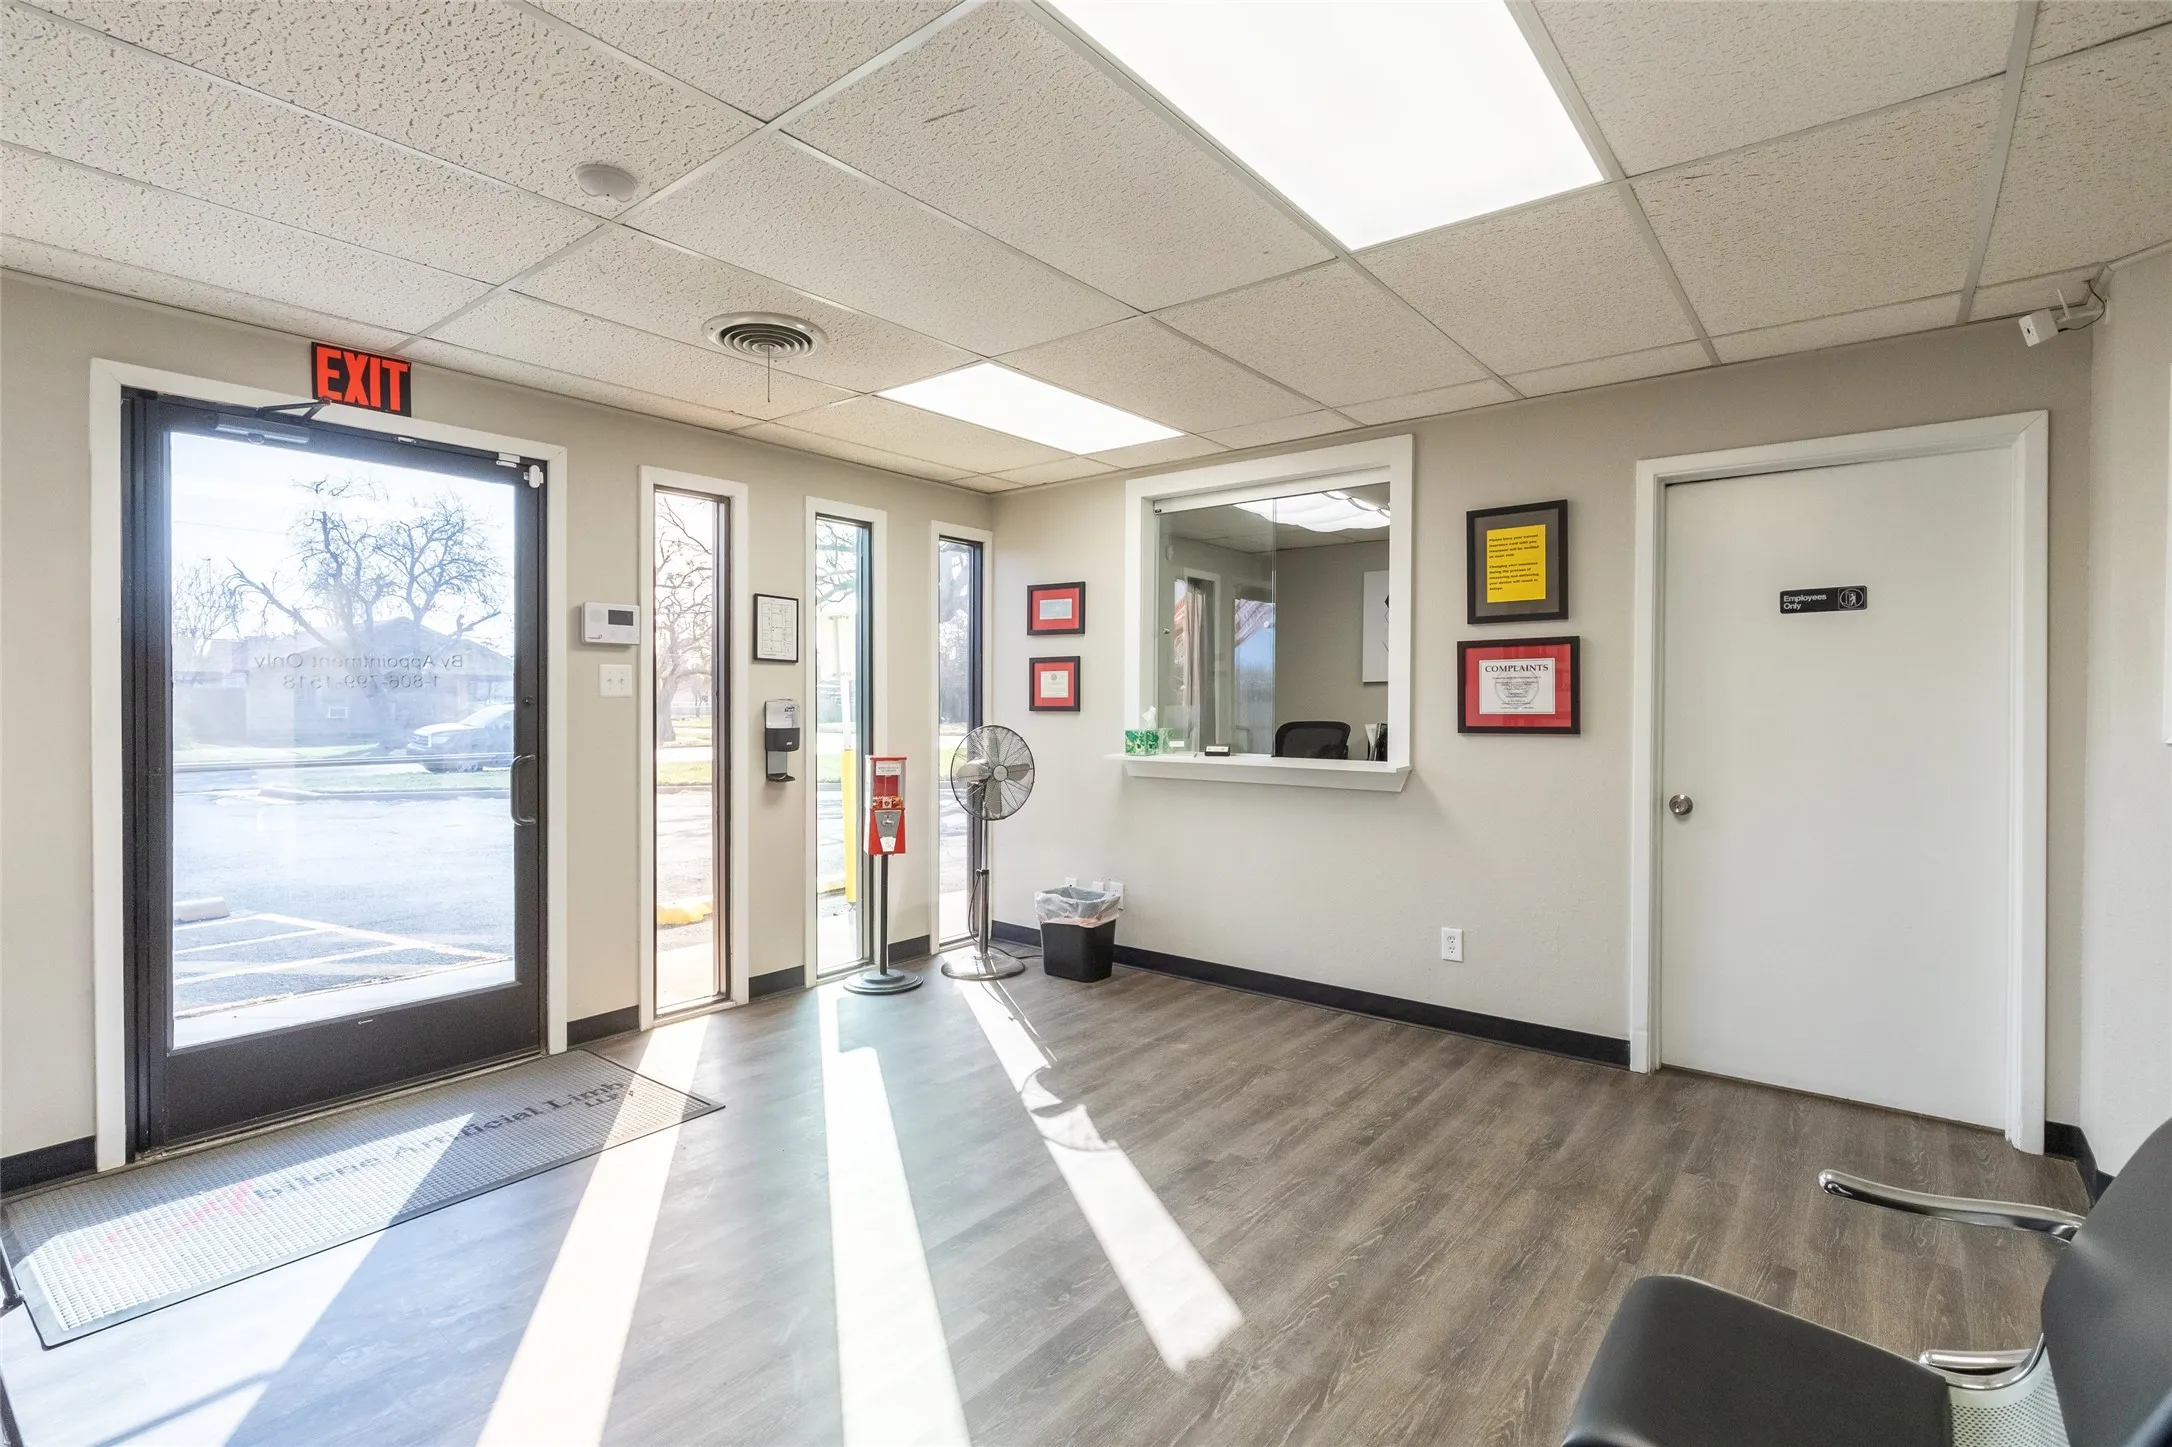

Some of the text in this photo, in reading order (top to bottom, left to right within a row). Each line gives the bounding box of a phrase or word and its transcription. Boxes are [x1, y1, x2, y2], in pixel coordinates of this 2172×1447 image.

[316, 345, 409, 412] EXIT
[1783, 593, 1828, 604] Employees
[1783, 602, 1802, 611] Only
[1484, 664, 1550, 673] COMPLAINTS
